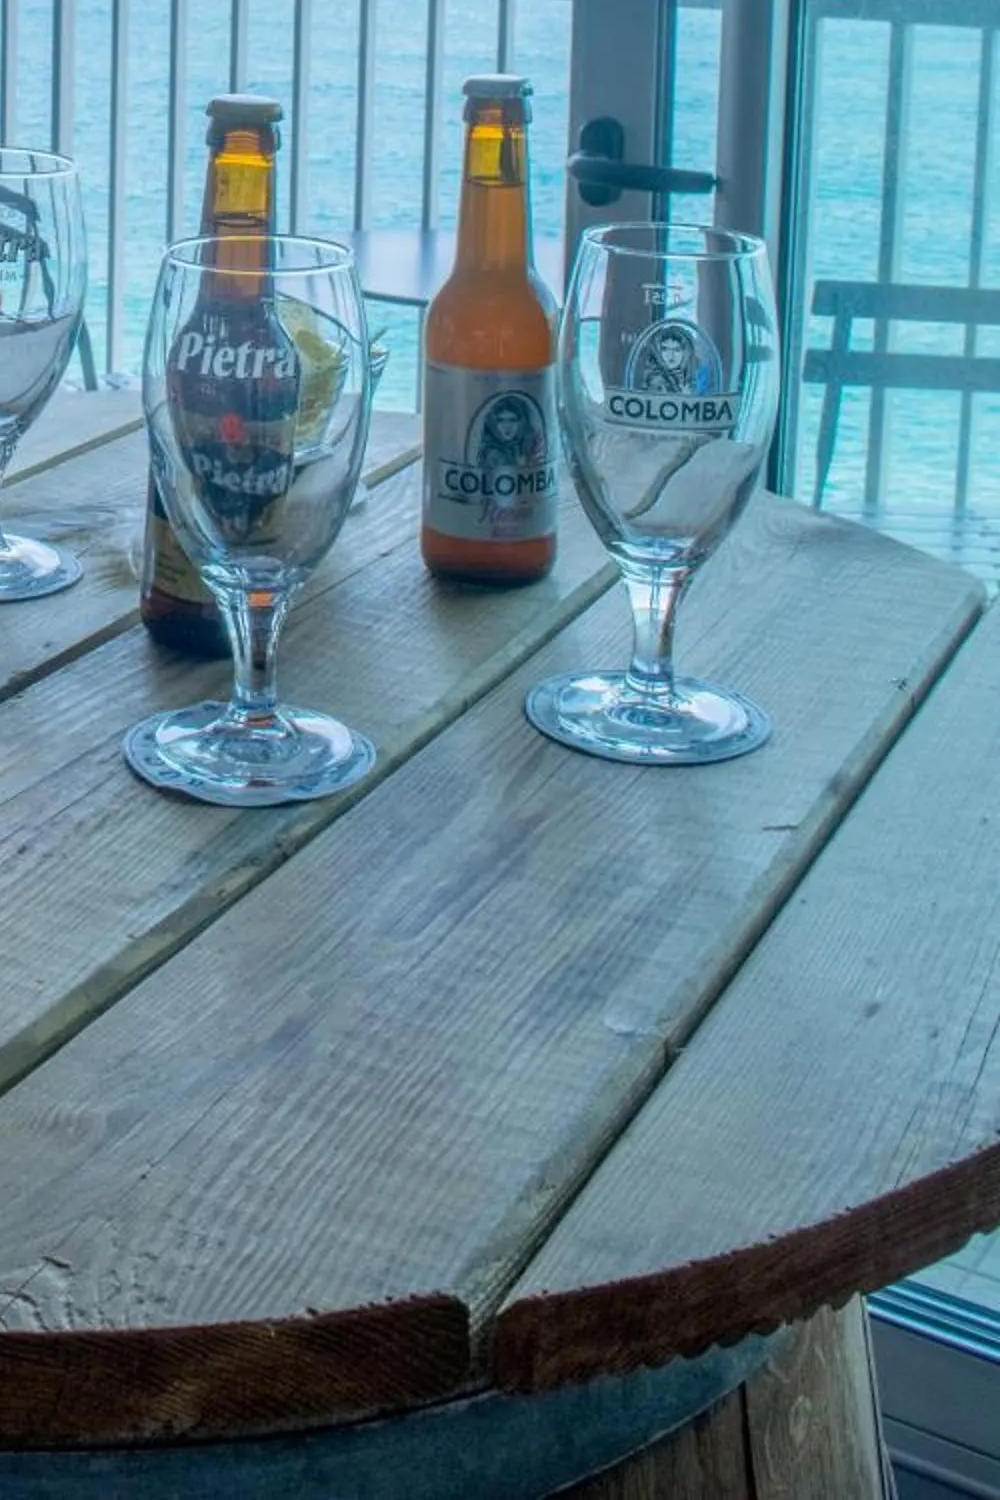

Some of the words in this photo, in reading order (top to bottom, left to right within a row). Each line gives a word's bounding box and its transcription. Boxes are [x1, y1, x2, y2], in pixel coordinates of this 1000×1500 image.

[177, 331, 296, 379] Pietra
[609, 395, 733, 422] COLOMBA
[192, 453, 289, 496] Pietra
[445, 467, 556, 496] COLOMBA
